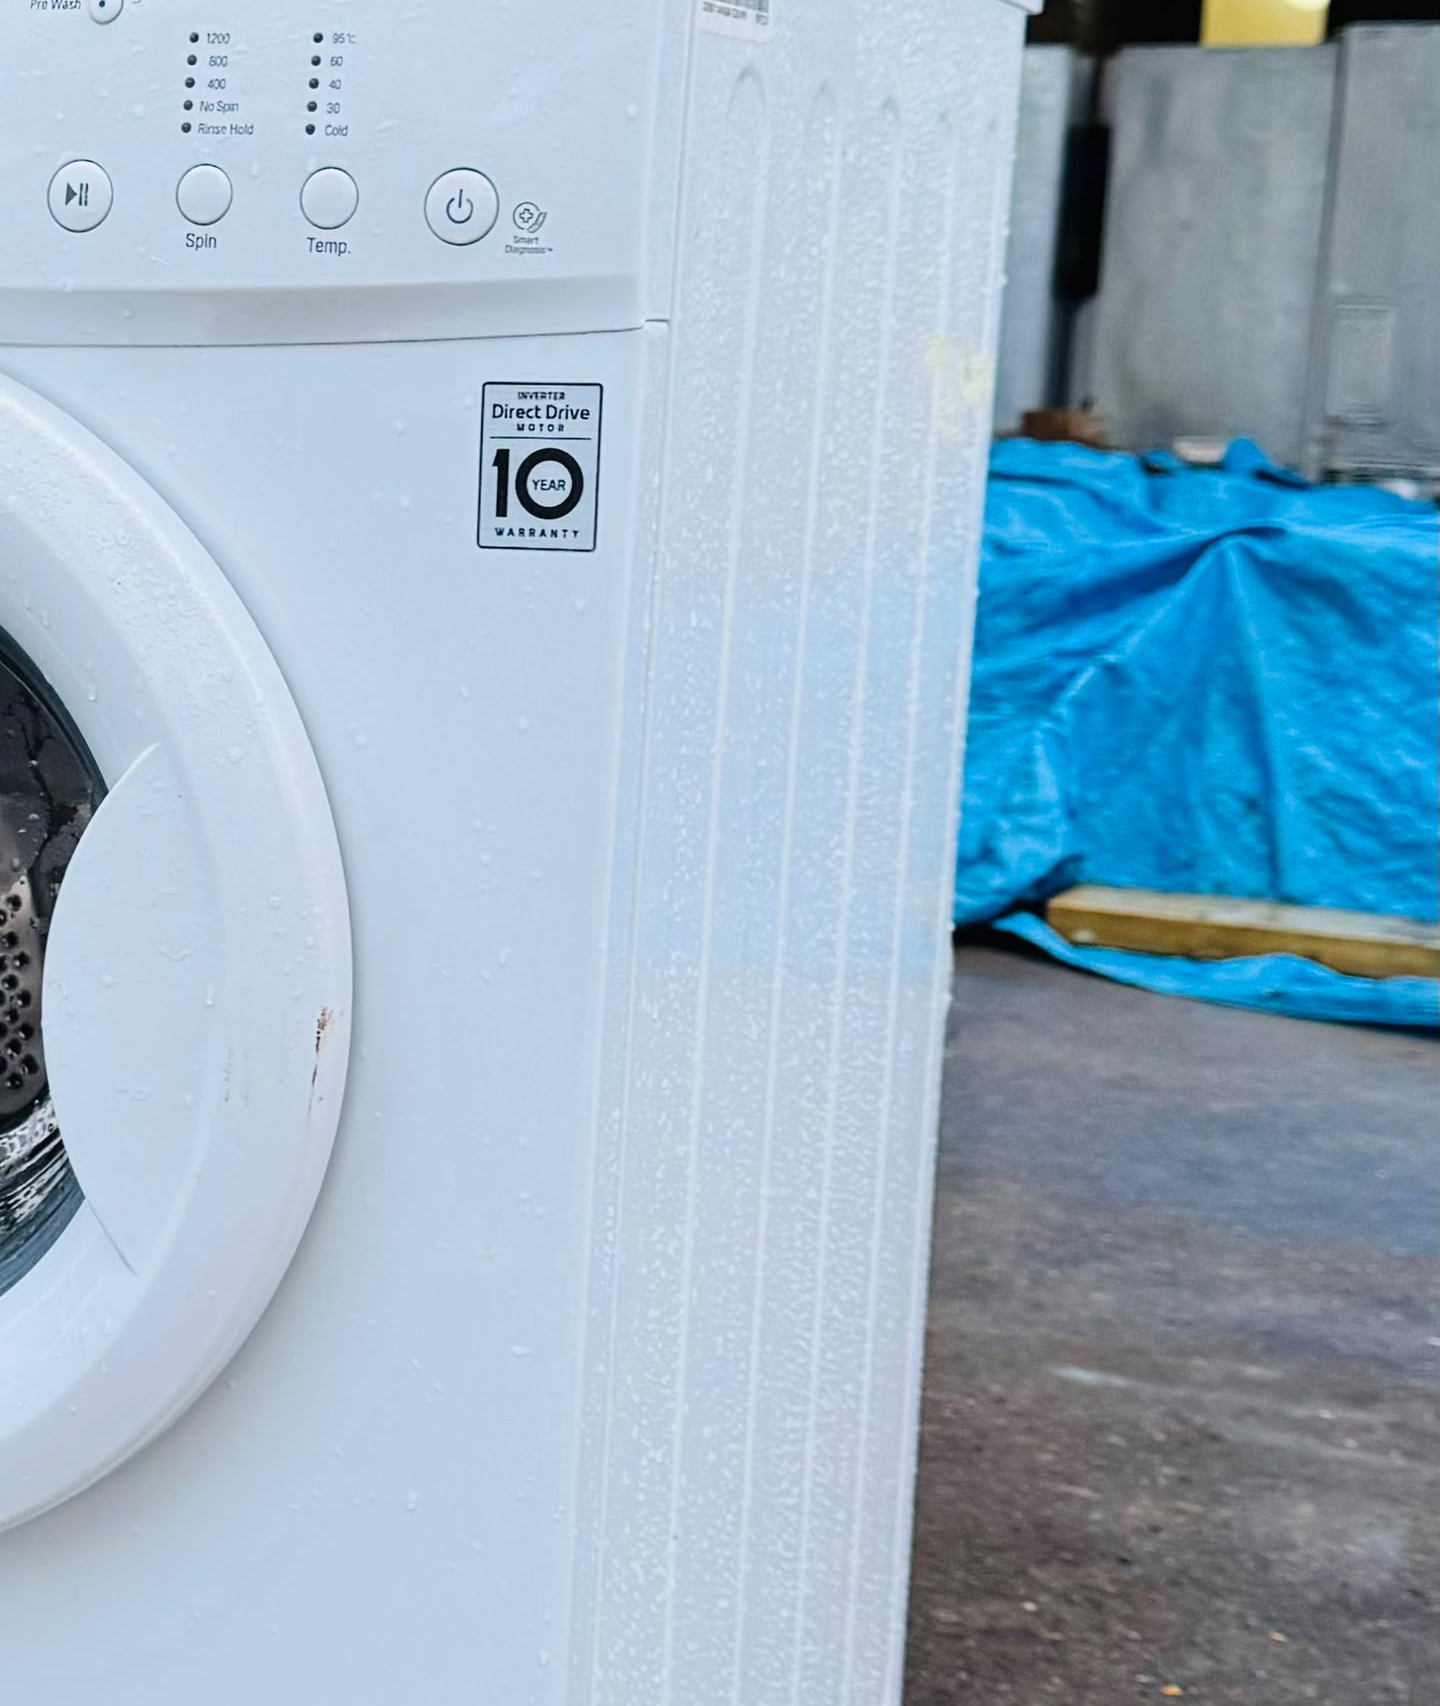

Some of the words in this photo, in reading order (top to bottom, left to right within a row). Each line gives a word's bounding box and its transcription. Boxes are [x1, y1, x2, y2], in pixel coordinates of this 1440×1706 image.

[206, 32, 231, 44] 1200
[207, 78, 227, 90] 400
[328, 78, 342, 90] 40
[199, 101, 215, 112] No
[216, 101, 240, 115] Spin
[326, 102, 341, 115] 30
[197, 123, 228, 135] Rinse
[229, 124, 254, 136] Hold
[324, 124, 349, 137] Cold
[185, 233, 217, 251] Spin
[306, 236, 352, 255] Temp.
[517, 392, 566, 401] INVERTER
[492, 403, 541, 419] Direct
[545, 404, 590, 420] Drive
[516, 423, 565, 432] MOTOR
[492, 448, 584, 519] 10
[532, 479, 566, 491] YEAR
[495, 527, 579, 538] WARRANTY
